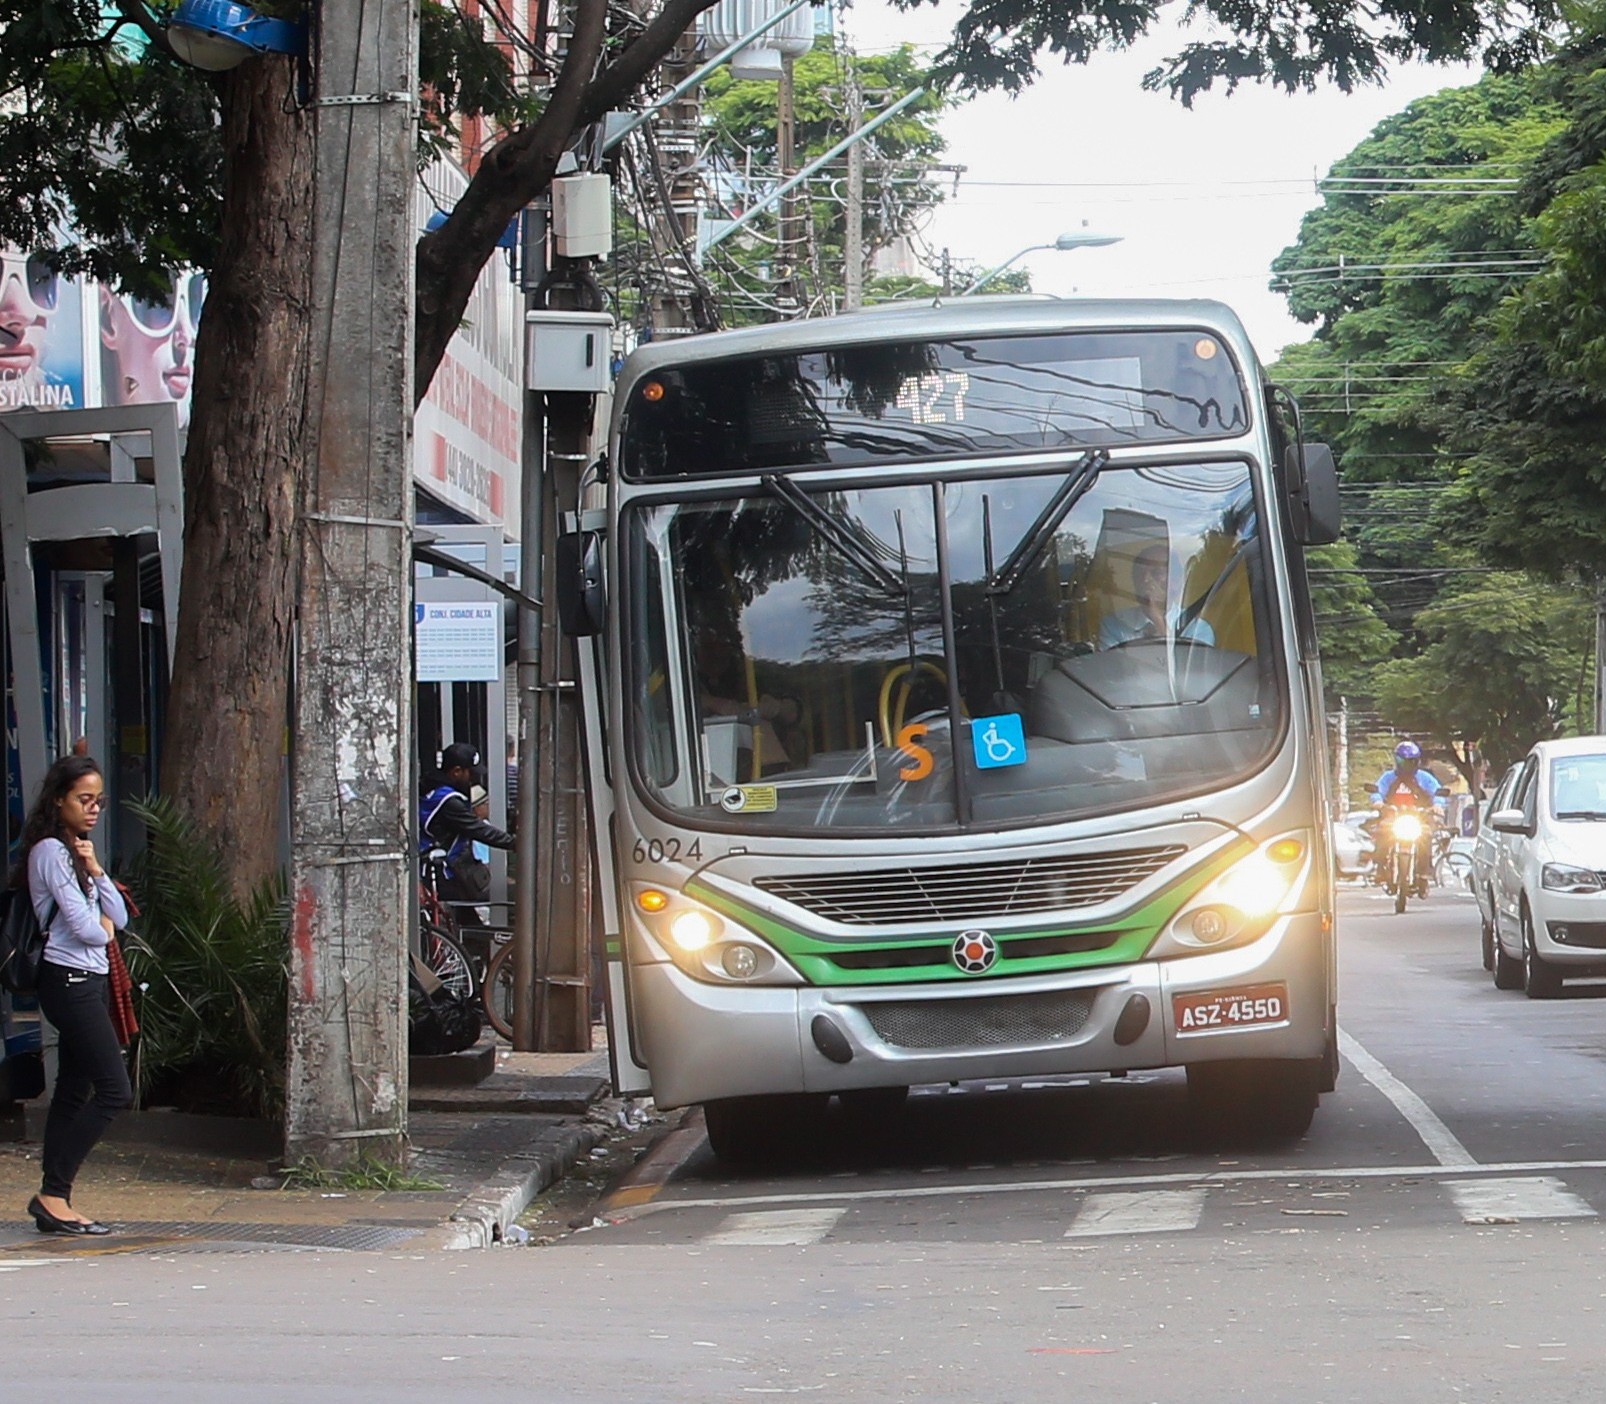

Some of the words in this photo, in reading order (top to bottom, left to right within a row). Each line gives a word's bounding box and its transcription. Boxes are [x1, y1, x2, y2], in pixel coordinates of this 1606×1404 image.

[896, 373, 969, 424] 427
[449, 609, 474, 619] CIDADE
[475, 609, 492, 619] ALTA
[896, 723, 934, 782] S
[632, 837, 703, 864] 6024
